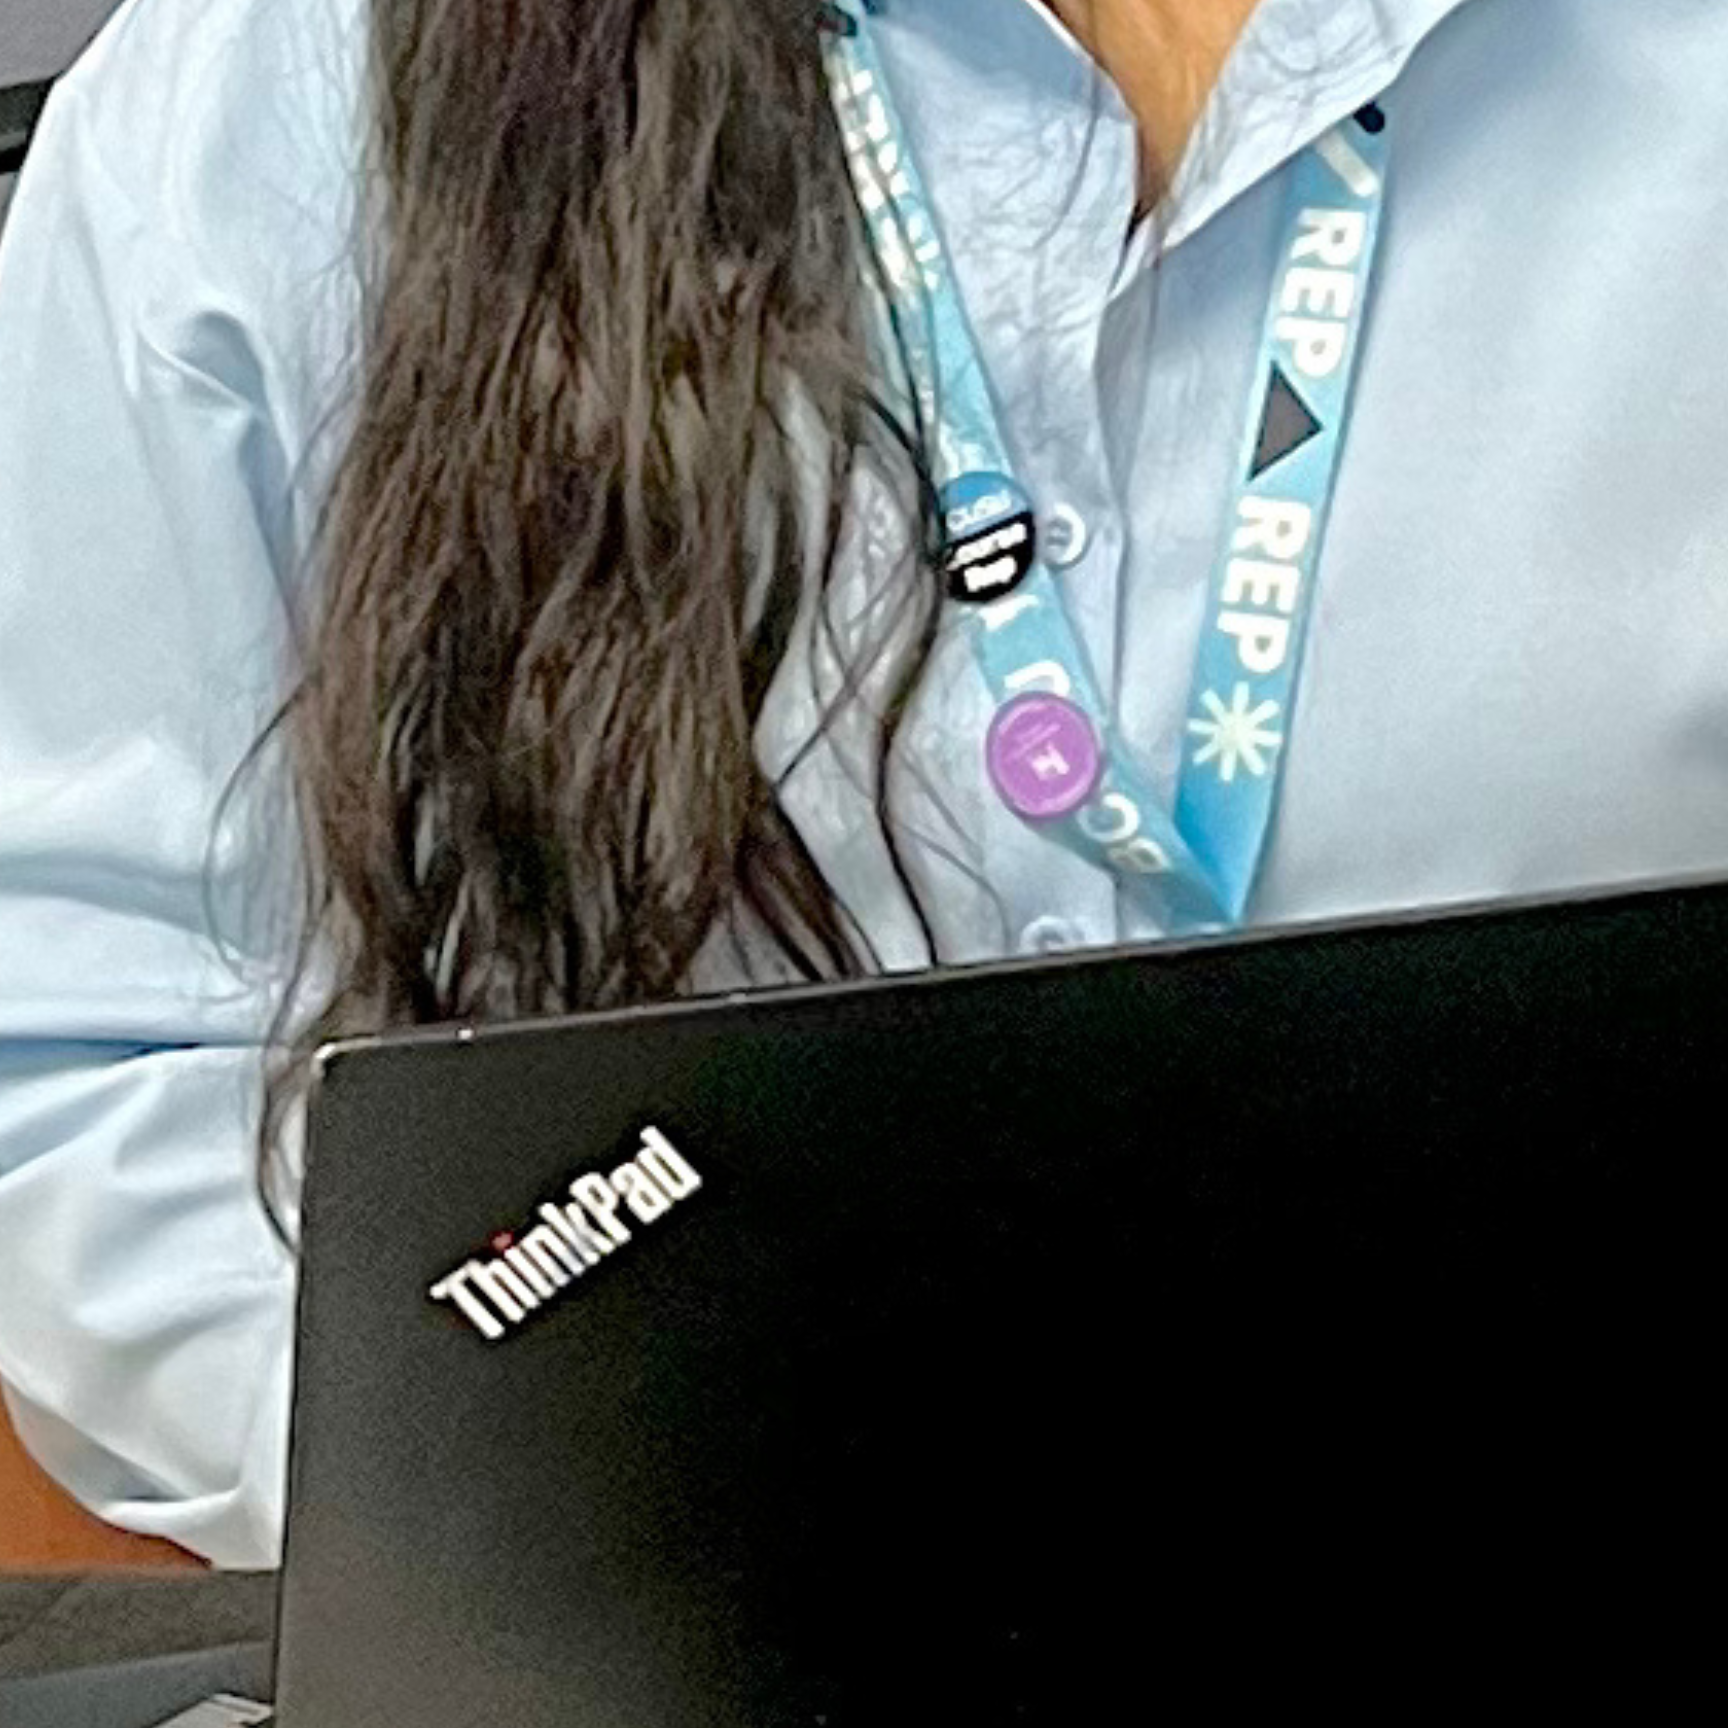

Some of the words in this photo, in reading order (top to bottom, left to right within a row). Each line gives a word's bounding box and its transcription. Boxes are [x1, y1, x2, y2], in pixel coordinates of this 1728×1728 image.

[1275, 208, 1367, 379] REP
[1217, 495, 1313, 674] REP
[429, 1124, 702, 1340] ThinkPad
